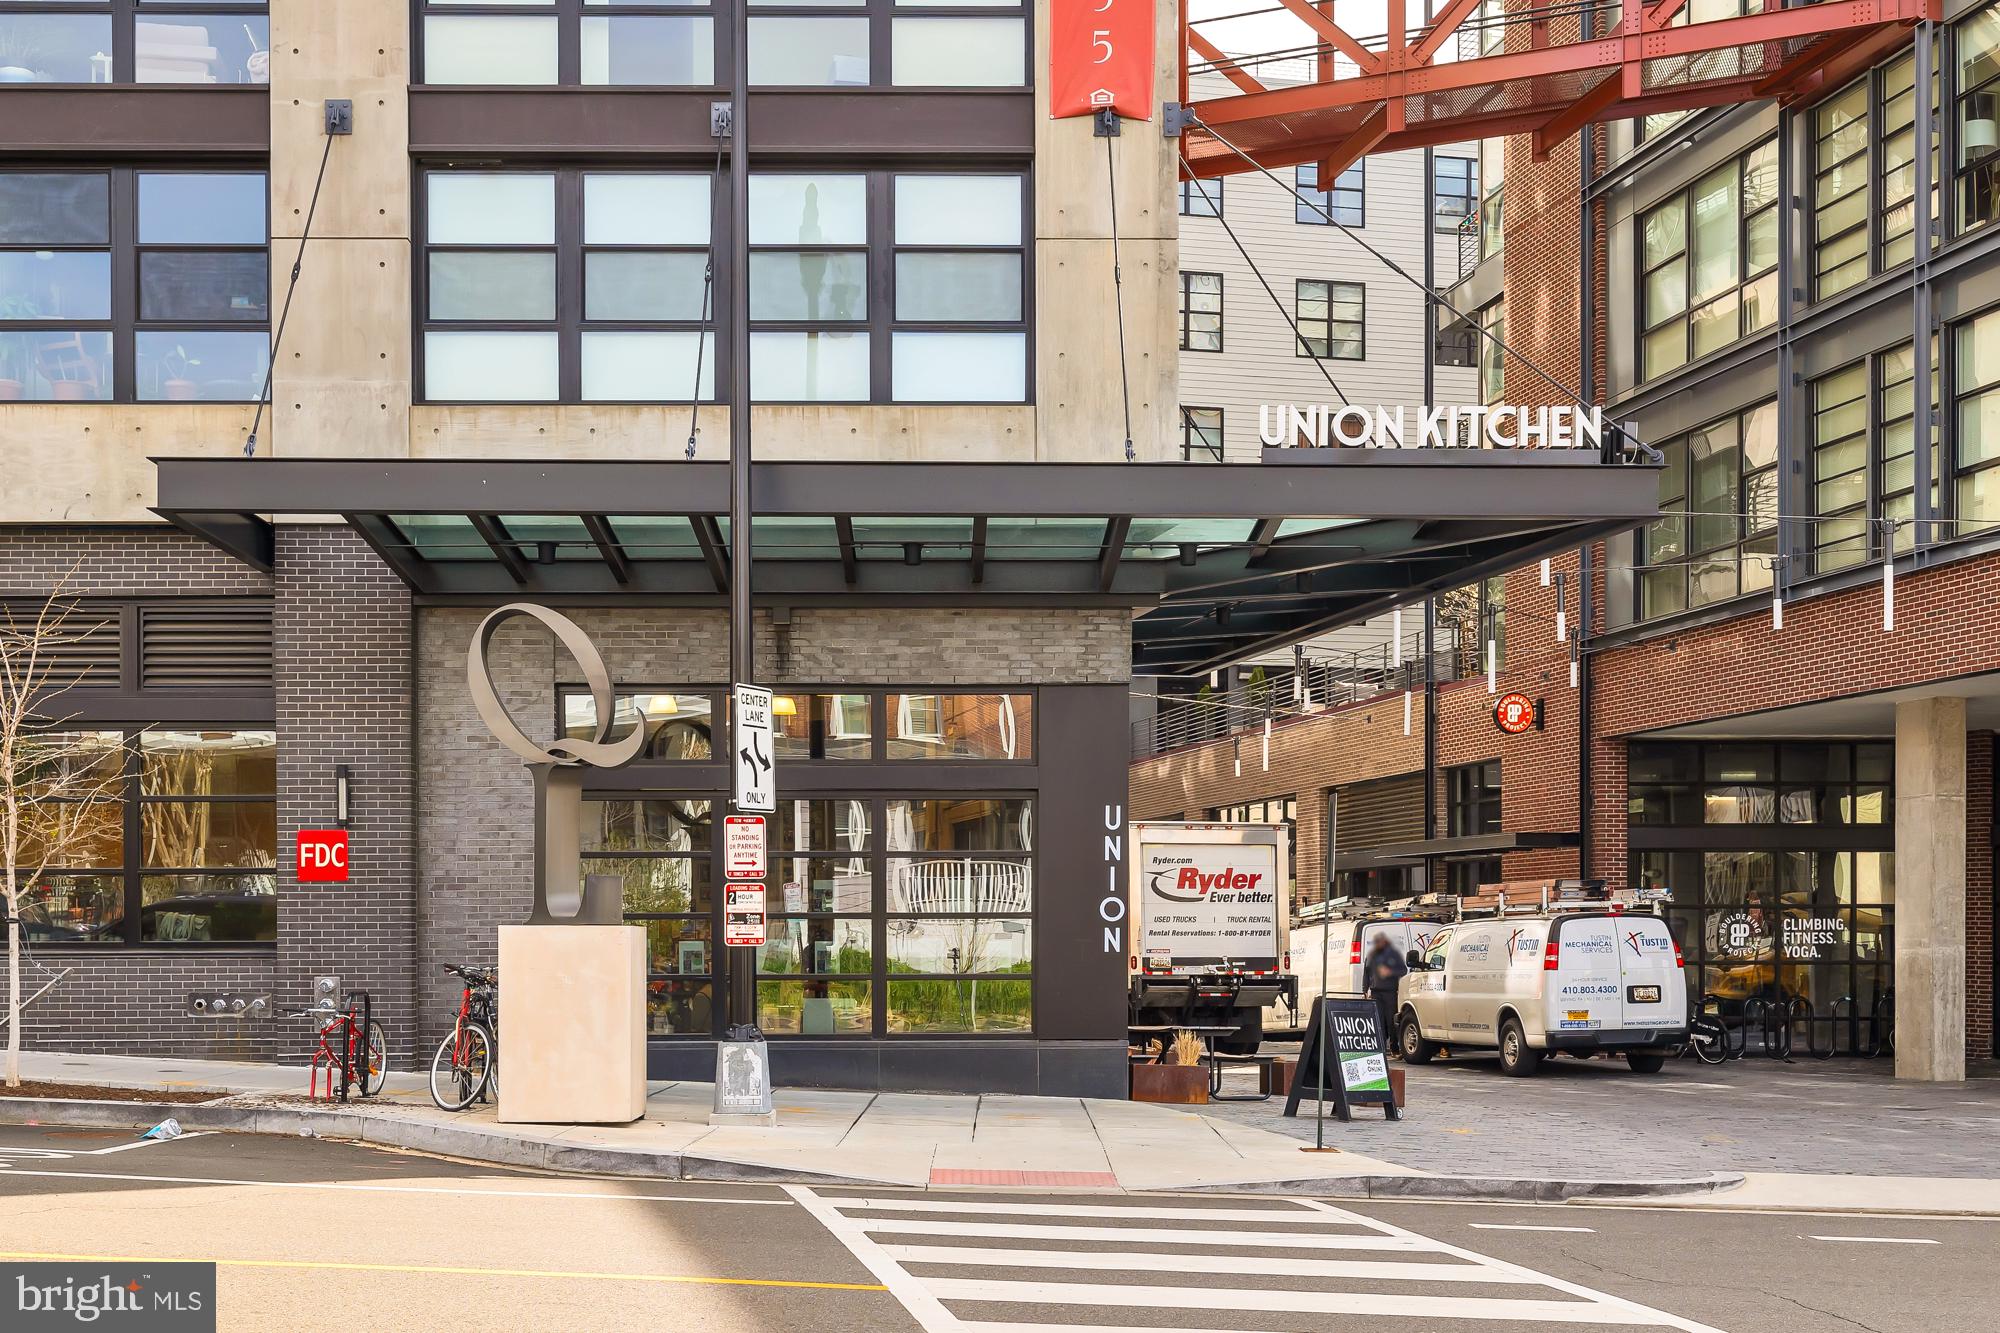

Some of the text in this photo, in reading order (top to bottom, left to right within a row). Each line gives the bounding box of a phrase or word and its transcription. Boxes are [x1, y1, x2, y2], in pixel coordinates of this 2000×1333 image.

[1259, 404, 1602, 448] UNION KITCHEN
[740, 692, 768, 708] CENTER
[744, 709, 765, 723] LANE
[745, 791, 766, 804] ONLY
[300, 842, 345, 868] FDC
[1152, 857, 1193, 866] Ryder.com
[1099, 805, 1126, 953] UNION
[1177, 867, 1262, 895] Ryder
[728, 892, 735, 904] 2
[1210, 892, 1273, 903] Ever better.
[1154, 916, 1272, 924] USED TRUCKS TRUCK RENTAL
[1719, 913, 1762, 935] BOULDERING
[1783, 918, 1848, 931] CLIMBING.
[1149, 929, 1171, 937] Rental
[1171, 929, 1217, 937] Reservations:
[1783, 932, 1837, 945] FITNESS.
[1459, 944, 1490, 953] MECHANICAL
[1722, 941, 1762, 957] PROJECT
[1784, 945, 1822, 958] YOGA.
[1562, 985, 1618, 995] 410.803.4300
[1333, 1016, 1376, 1035] UNION
[1337, 1036, 1378, 1050] KITCHEN
